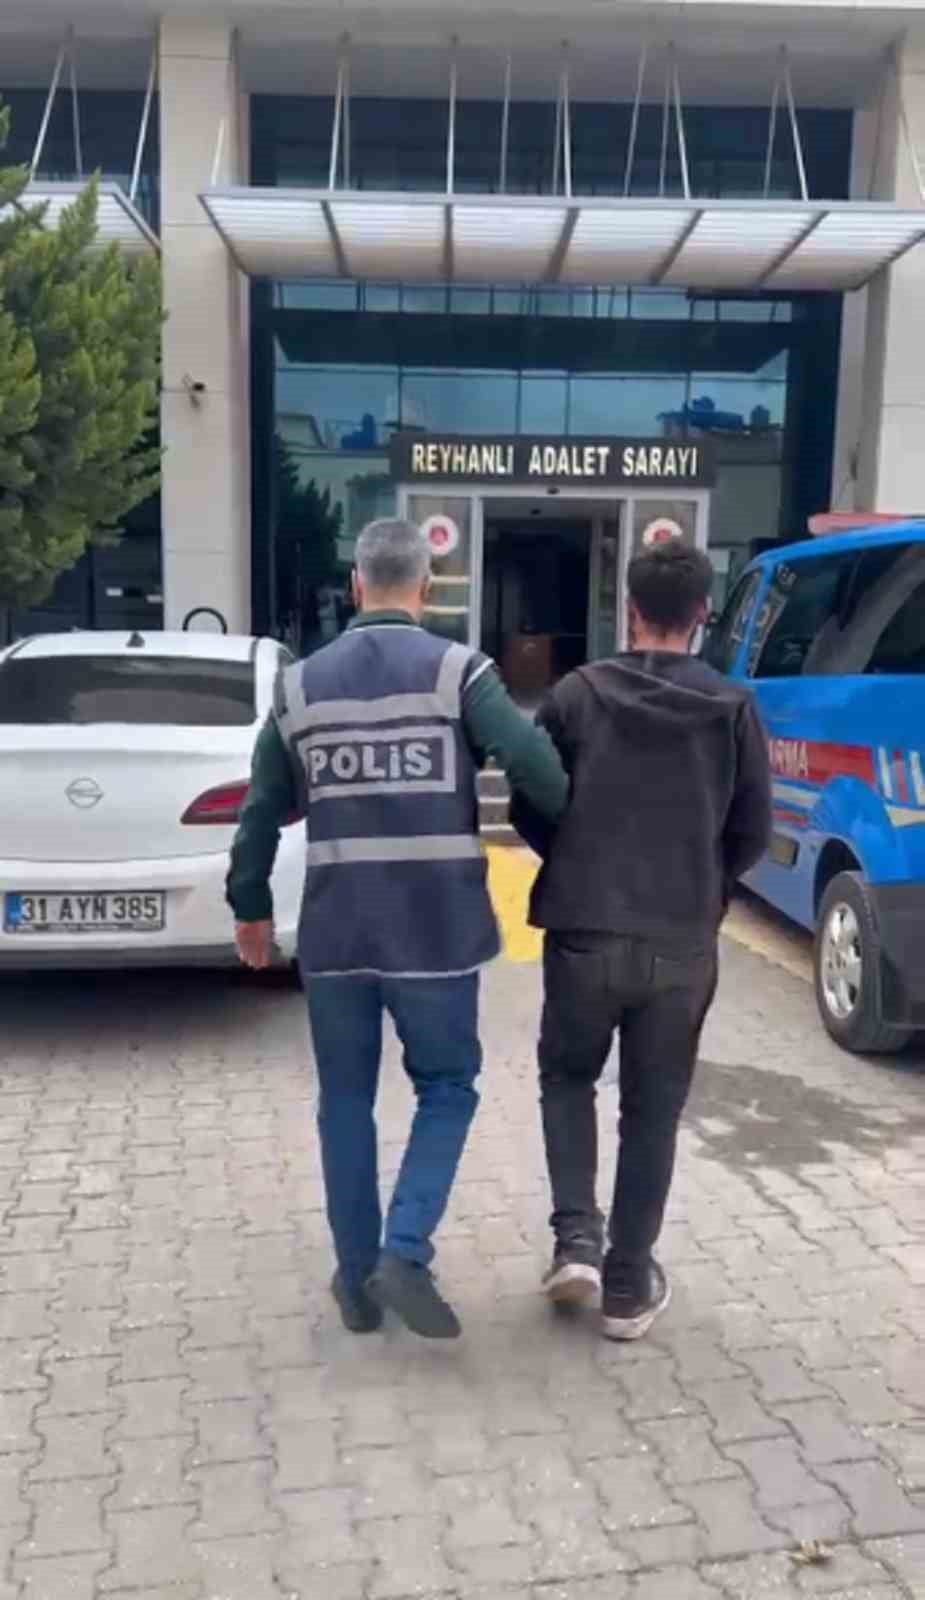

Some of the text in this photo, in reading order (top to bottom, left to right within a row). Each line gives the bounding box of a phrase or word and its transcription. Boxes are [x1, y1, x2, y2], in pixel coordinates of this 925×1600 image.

[411, 443, 697, 476] REYHANLI ADALET SARAYI
[21, 897, 48, 921] 31
[112, 896, 158, 920] 385
